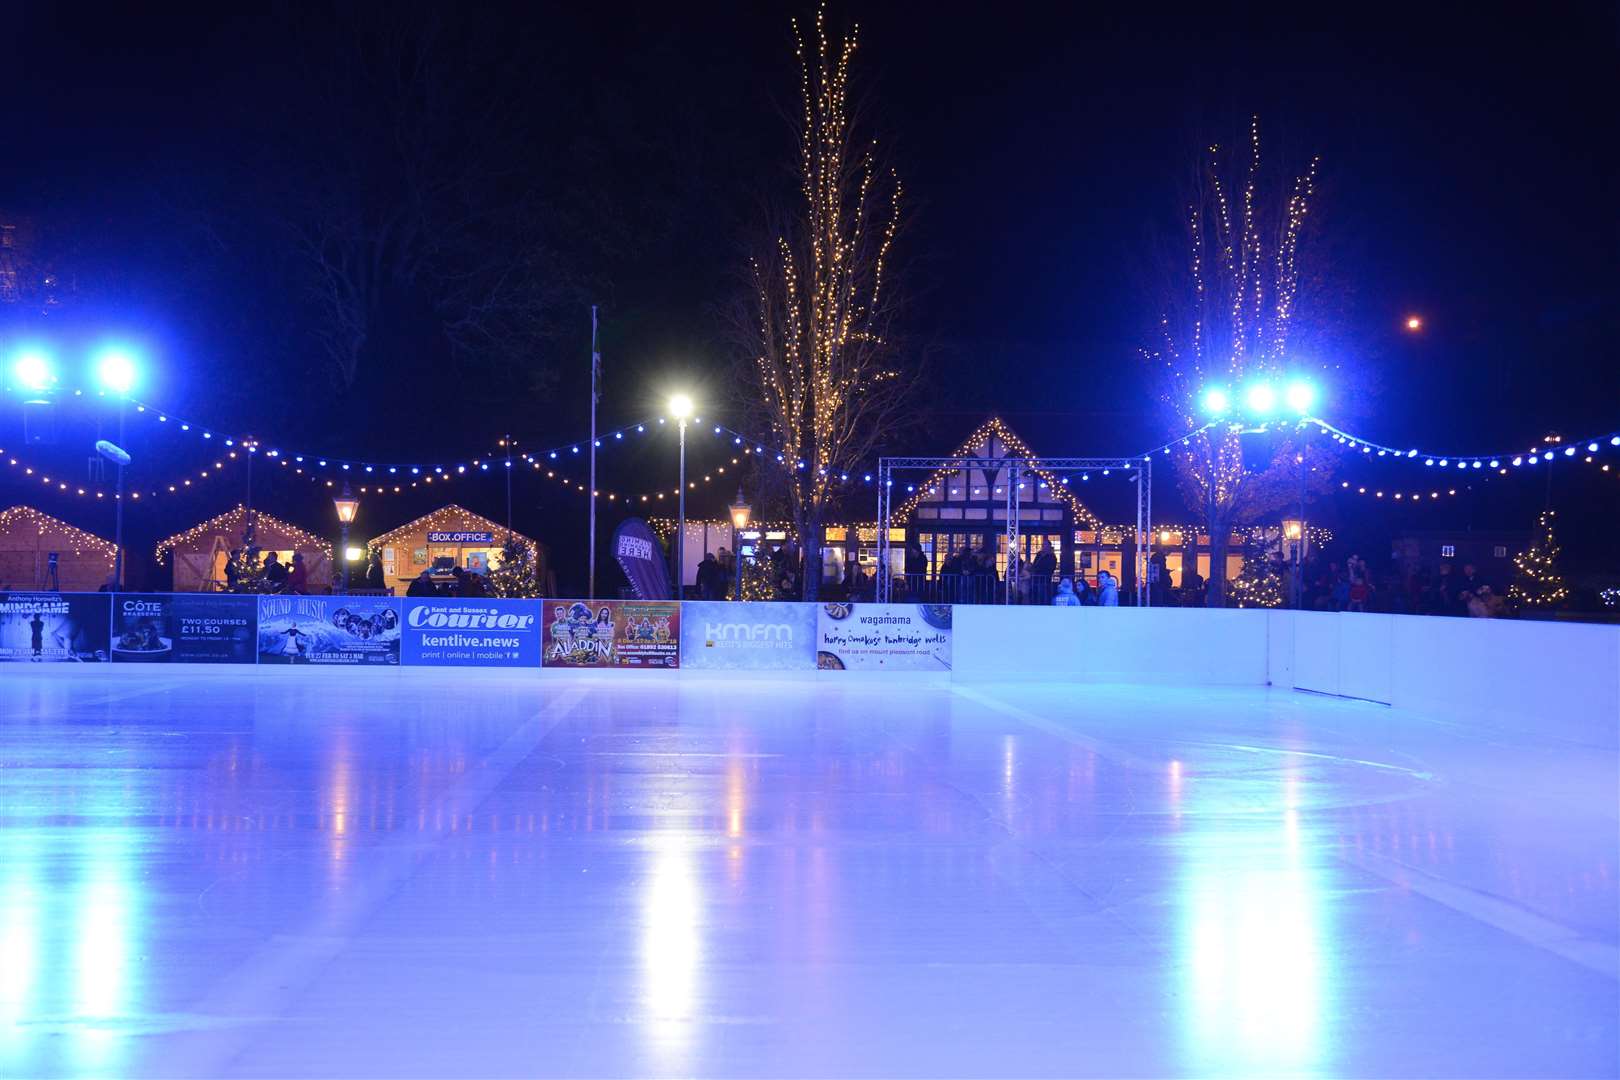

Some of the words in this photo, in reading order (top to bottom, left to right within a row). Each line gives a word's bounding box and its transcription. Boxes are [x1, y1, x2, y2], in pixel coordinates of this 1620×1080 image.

[432, 533, 451, 541] BOX
[454, 533, 487, 541] OFFICE
[0, 602, 69, 613] MINDGAME
[123, 600, 161, 611] CÔTE
[261, 598, 291, 621] SOUND
[297, 598, 328, 620] MUSIC
[408, 605, 534, 628] Courier
[860, 616, 911, 625] wagamama
[422, 634, 519, 647] kentlive.news
[925, 633, 946, 644] wells
[422, 651, 440, 659] print
[447, 651, 470, 659] online
[477, 651, 503, 659] mobile
